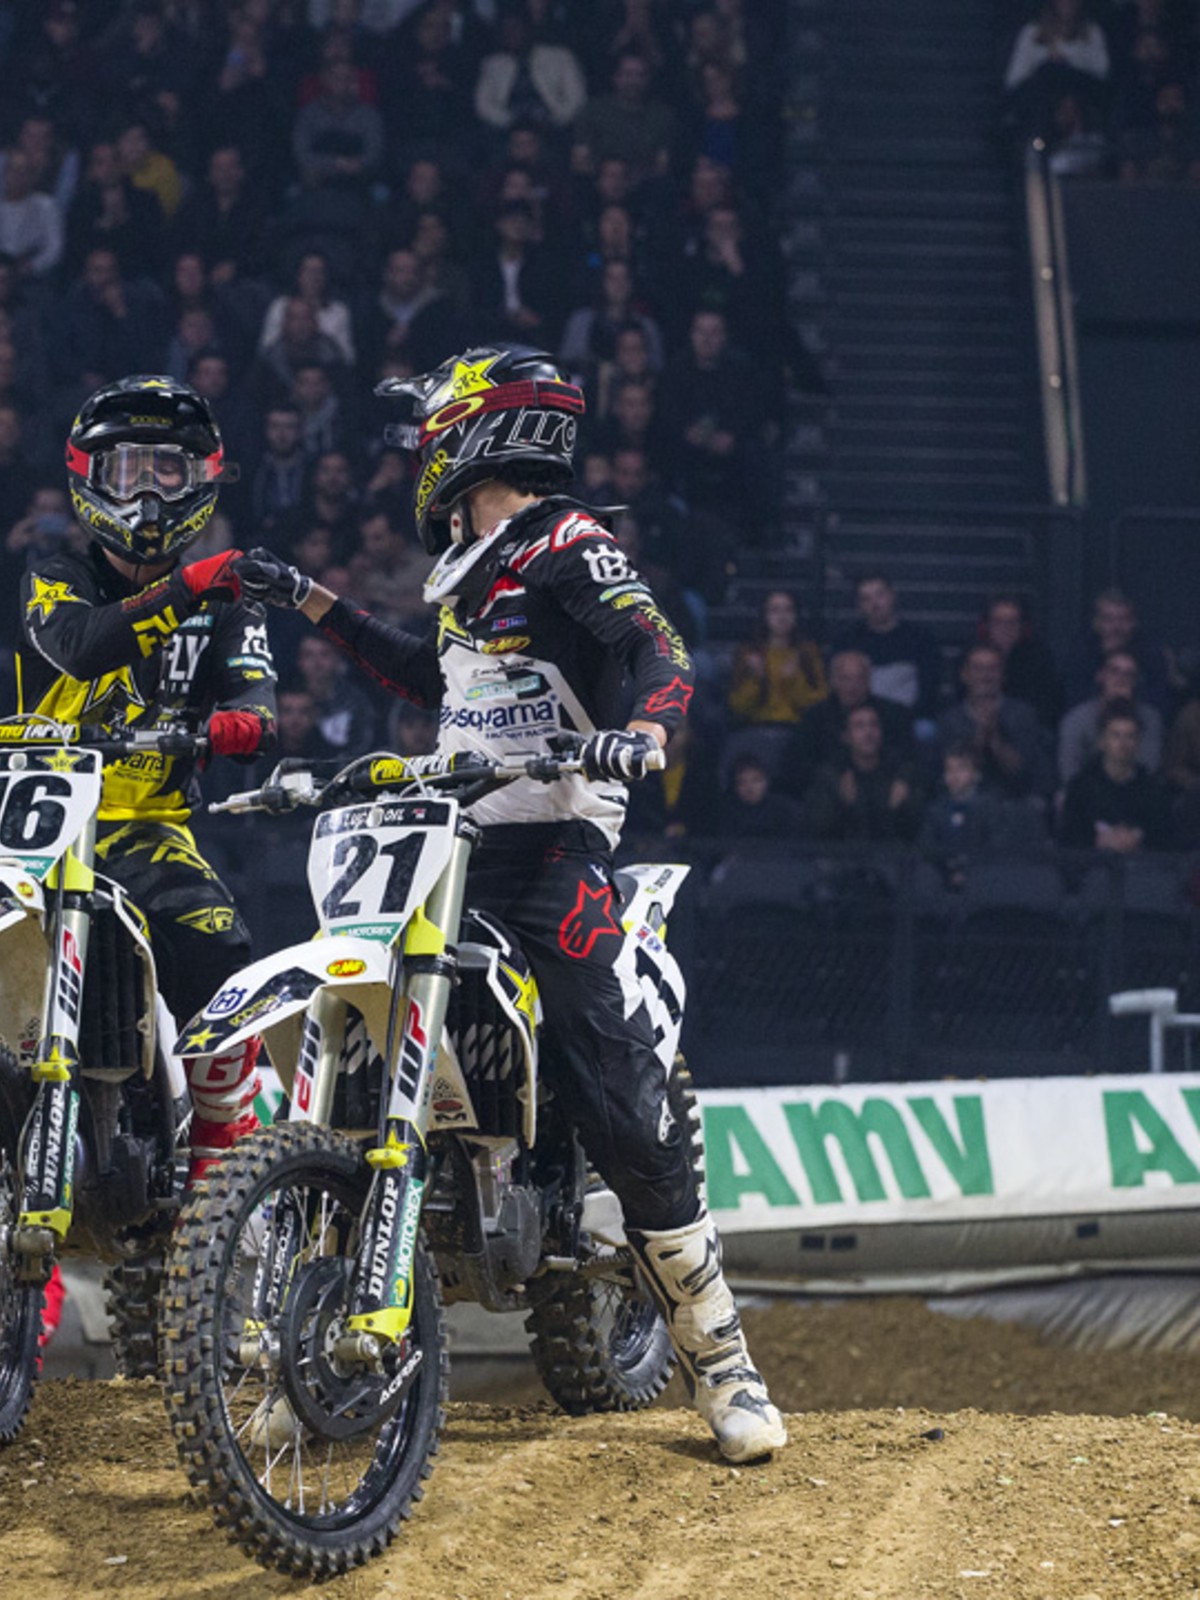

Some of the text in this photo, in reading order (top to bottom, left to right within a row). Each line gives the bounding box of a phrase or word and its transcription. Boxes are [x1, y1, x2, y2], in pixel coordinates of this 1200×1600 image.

[321, 831, 428, 919] 21
[41, 1087, 65, 1200] DUNLOP
[368, 1176, 401, 1301] DUNLOP
[396, 1181, 424, 1279] MOTOREX
